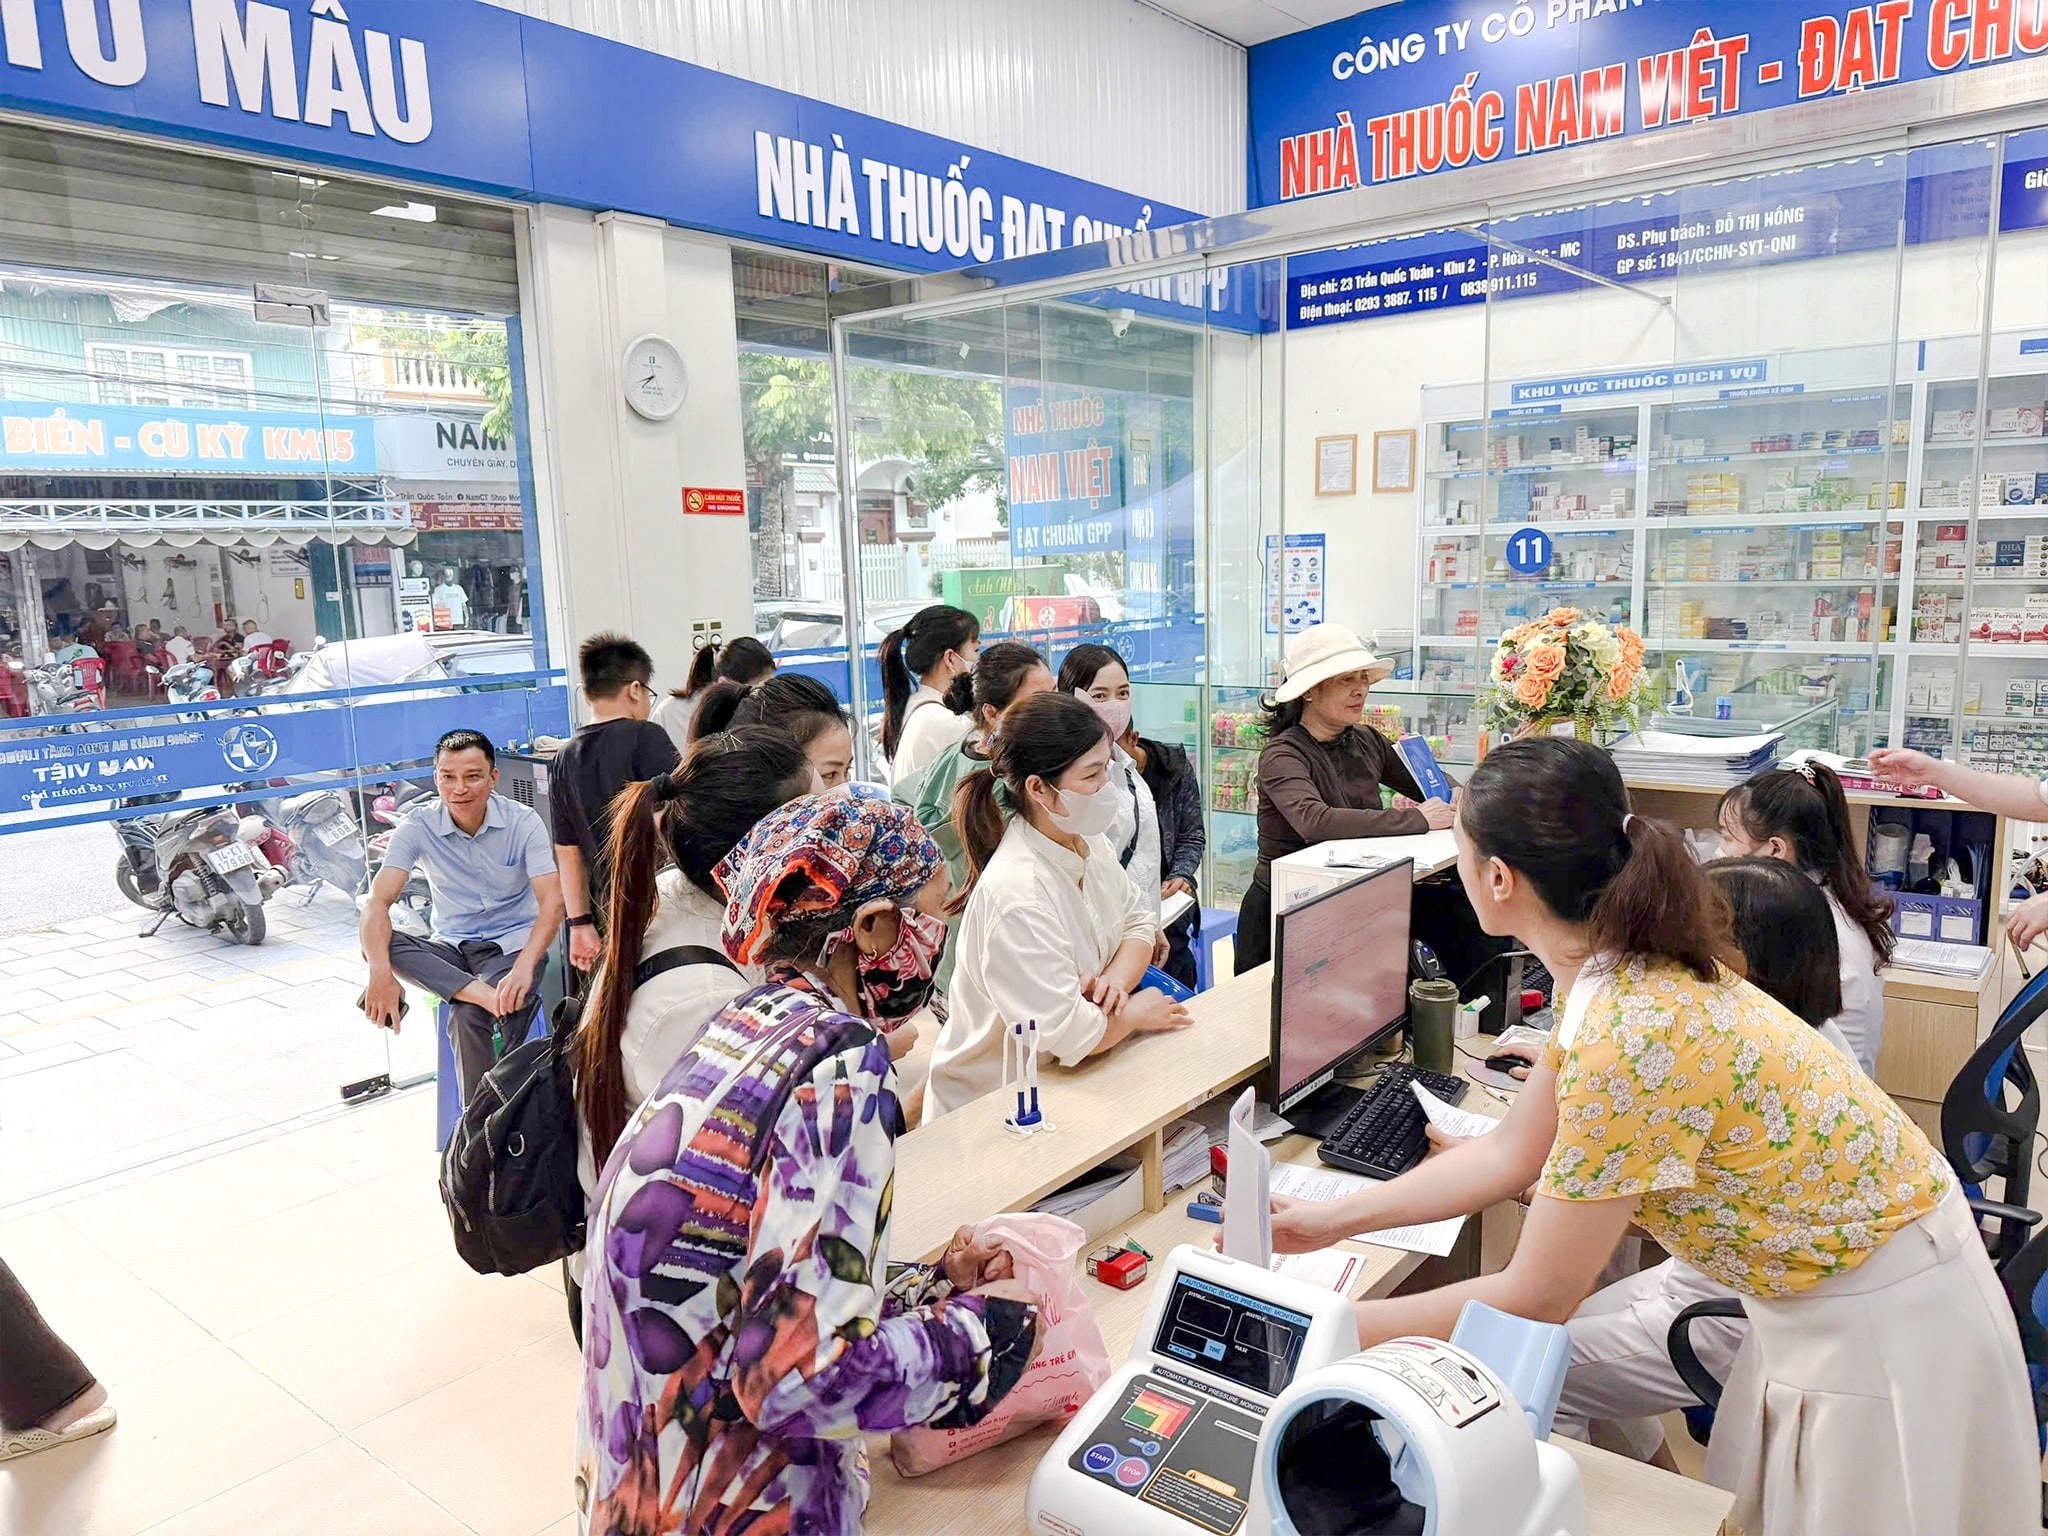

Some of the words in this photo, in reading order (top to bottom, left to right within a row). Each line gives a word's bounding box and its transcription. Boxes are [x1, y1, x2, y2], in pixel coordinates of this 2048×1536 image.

[1332, 36, 1425, 80] CÔNG
[1434, 20, 1472, 55] TY
[1280, 111, 1362, 200] NHÀ
[1367, 71, 1504, 182] THUỐC
[1514, 62, 1626, 156] NAM
[1637, 27, 1749, 129] VIỆT
[1757, 60, 1783, 85] -
[1798, 1, 1914, 98] ĐẠT
[754, 131, 860, 236] NHÀ
[861, 154, 994, 263] THUỐC
[1670, 222, 1711, 242] trách:
[1715, 211, 1734, 234] ĐỖ
[1738, 210, 1760, 232] THỊ
[1764, 205, 1805, 228] HỒNG
[1300, 283, 1317, 299] Địa
[1319, 277, 1338, 295] chỉ:
[1340, 277, 1353, 292] 23
[1355, 271, 1377, 289] Trần
[1380, 267, 1407, 287] Quốc
[1409, 263, 1434, 282] Toản
[1444, 260, 1465, 276] Khu
[1467, 258, 1476, 273] 2
[1489, 254, 1500, 269] P.
[1560, 241, 1581, 259] MC
[1617, 258, 1635, 275] GP
[1637, 251, 1657, 272] số:
[1300, 303, 1322, 321] Điện
[1324, 298, 1353, 318] thoại:
[1354, 295, 1380, 312] 0203
[1383, 291, 1413, 308] 3887.
[1417, 286, 1438, 303] 115
[1442, 285, 1449, 300] /
[1460, 280, 1488, 297] 0838
[1490, 272, 1537, 292] 911.115
[1518, 386, 1556, 400] KHU
[1561, 381, 1599, 396] VỰC
[1604, 372, 1669, 391] THUỐC
[1673, 370, 1723, 386] DỊCH
[1729, 366, 1757, 381] VỤ
[1013, 399, 1047, 436] NHÀ
[1050, 391, 1105, 432] THUỐC
[2, 407, 105, 456] BIỂN
[114, 436, 132, 449] -
[138, 419, 189, 458] CÙ
[196, 421, 250, 459] KỲ
[262, 426, 355, 463] KM15
[436, 422, 507, 450] NAM
[1010, 452, 1061, 505] NAM
[1064, 437, 1112, 510] VIỆT
[1043, 515, 1084, 547] CHUẨN
[1087, 521, 1112, 544] GPP
[1515, 537, 1543, 565] 11
[214, 845, 243, 861] 14-K1
[1185, 1278, 1217, 1294] AUTOMATIC
[1218, 1288, 1239, 1302] BLOOD
[1240, 1295, 1272, 1313] PRESSURE
[1274, 1307, 1303, 1323] MONITOR
[1028, 1360, 1047, 1371] ANG
[1208, 1345, 1221, 1355] TIME
[1234, 1344, 1249, 1354] PULSE
[1155, 1367, 1187, 1384] AUTOMATIC
[1188, 1378, 1207, 1392] BLOOD
[1207, 1387, 1239, 1404] PRESSURE
[1239, 1399, 1268, 1415] MONITOR
[1089, 1451, 1112, 1464] START
[1122, 1465, 1142, 1477] STOP
[1198, 1474, 1235, 1495] CAUTION
